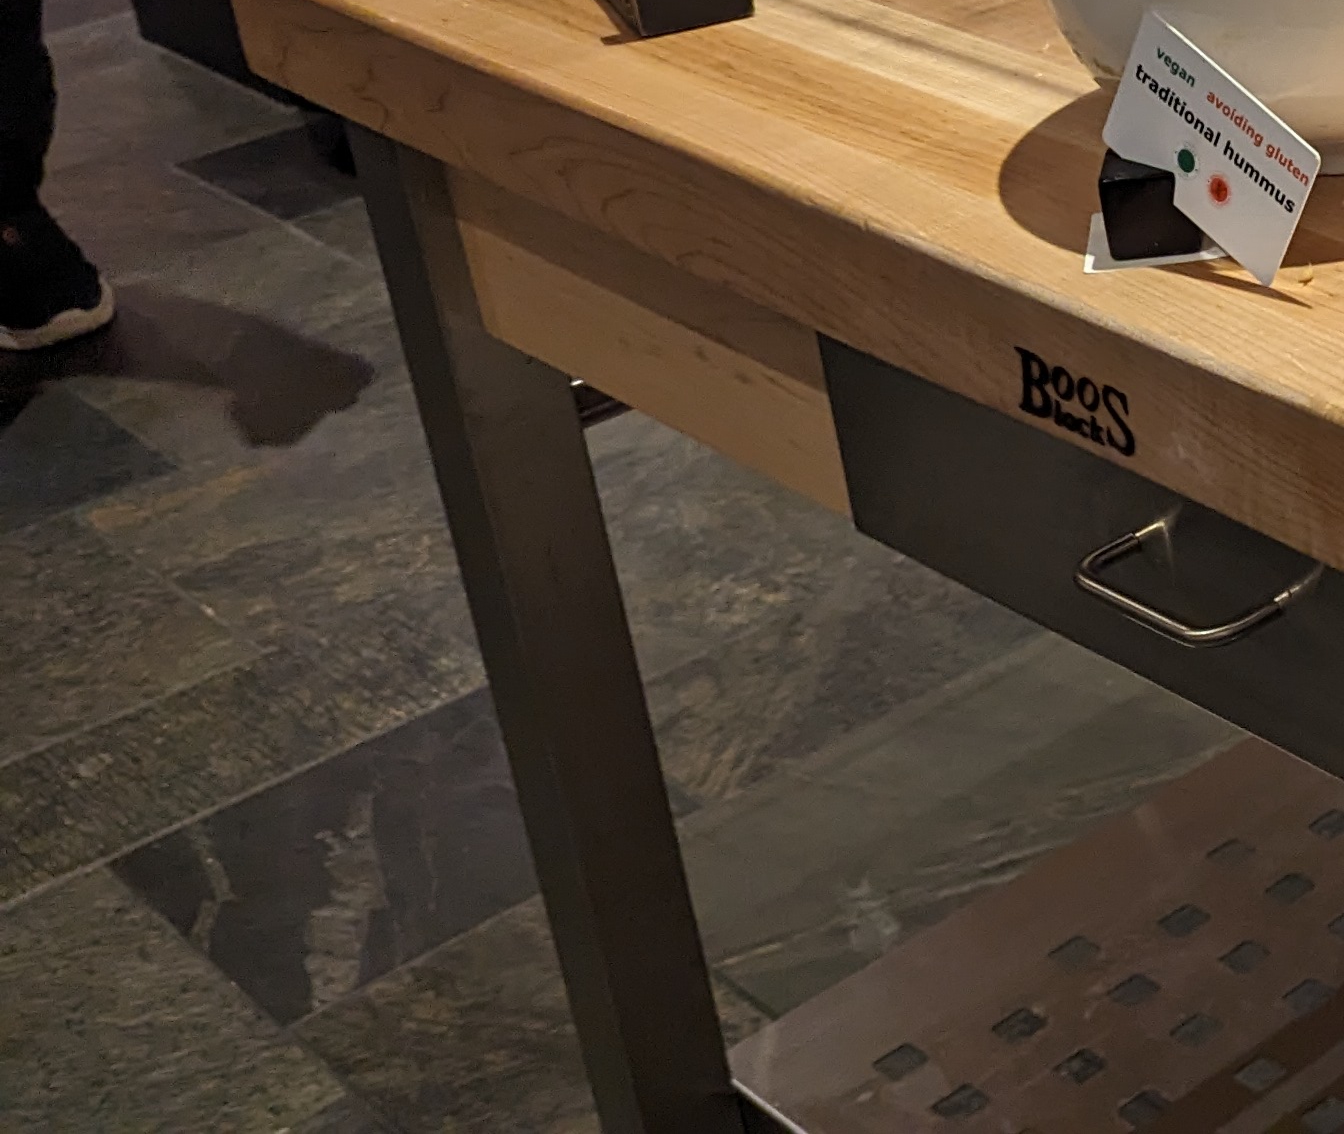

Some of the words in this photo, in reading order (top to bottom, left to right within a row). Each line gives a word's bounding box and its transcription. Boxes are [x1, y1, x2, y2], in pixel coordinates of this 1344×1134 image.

[1135, 64, 1221, 147] traditional
[1223, 140, 1297, 214] hummus
[1156, 47, 1196, 88] vegan
[1206, 91, 1264, 147] avoiding
[1265, 143, 1310, 187] gluten
